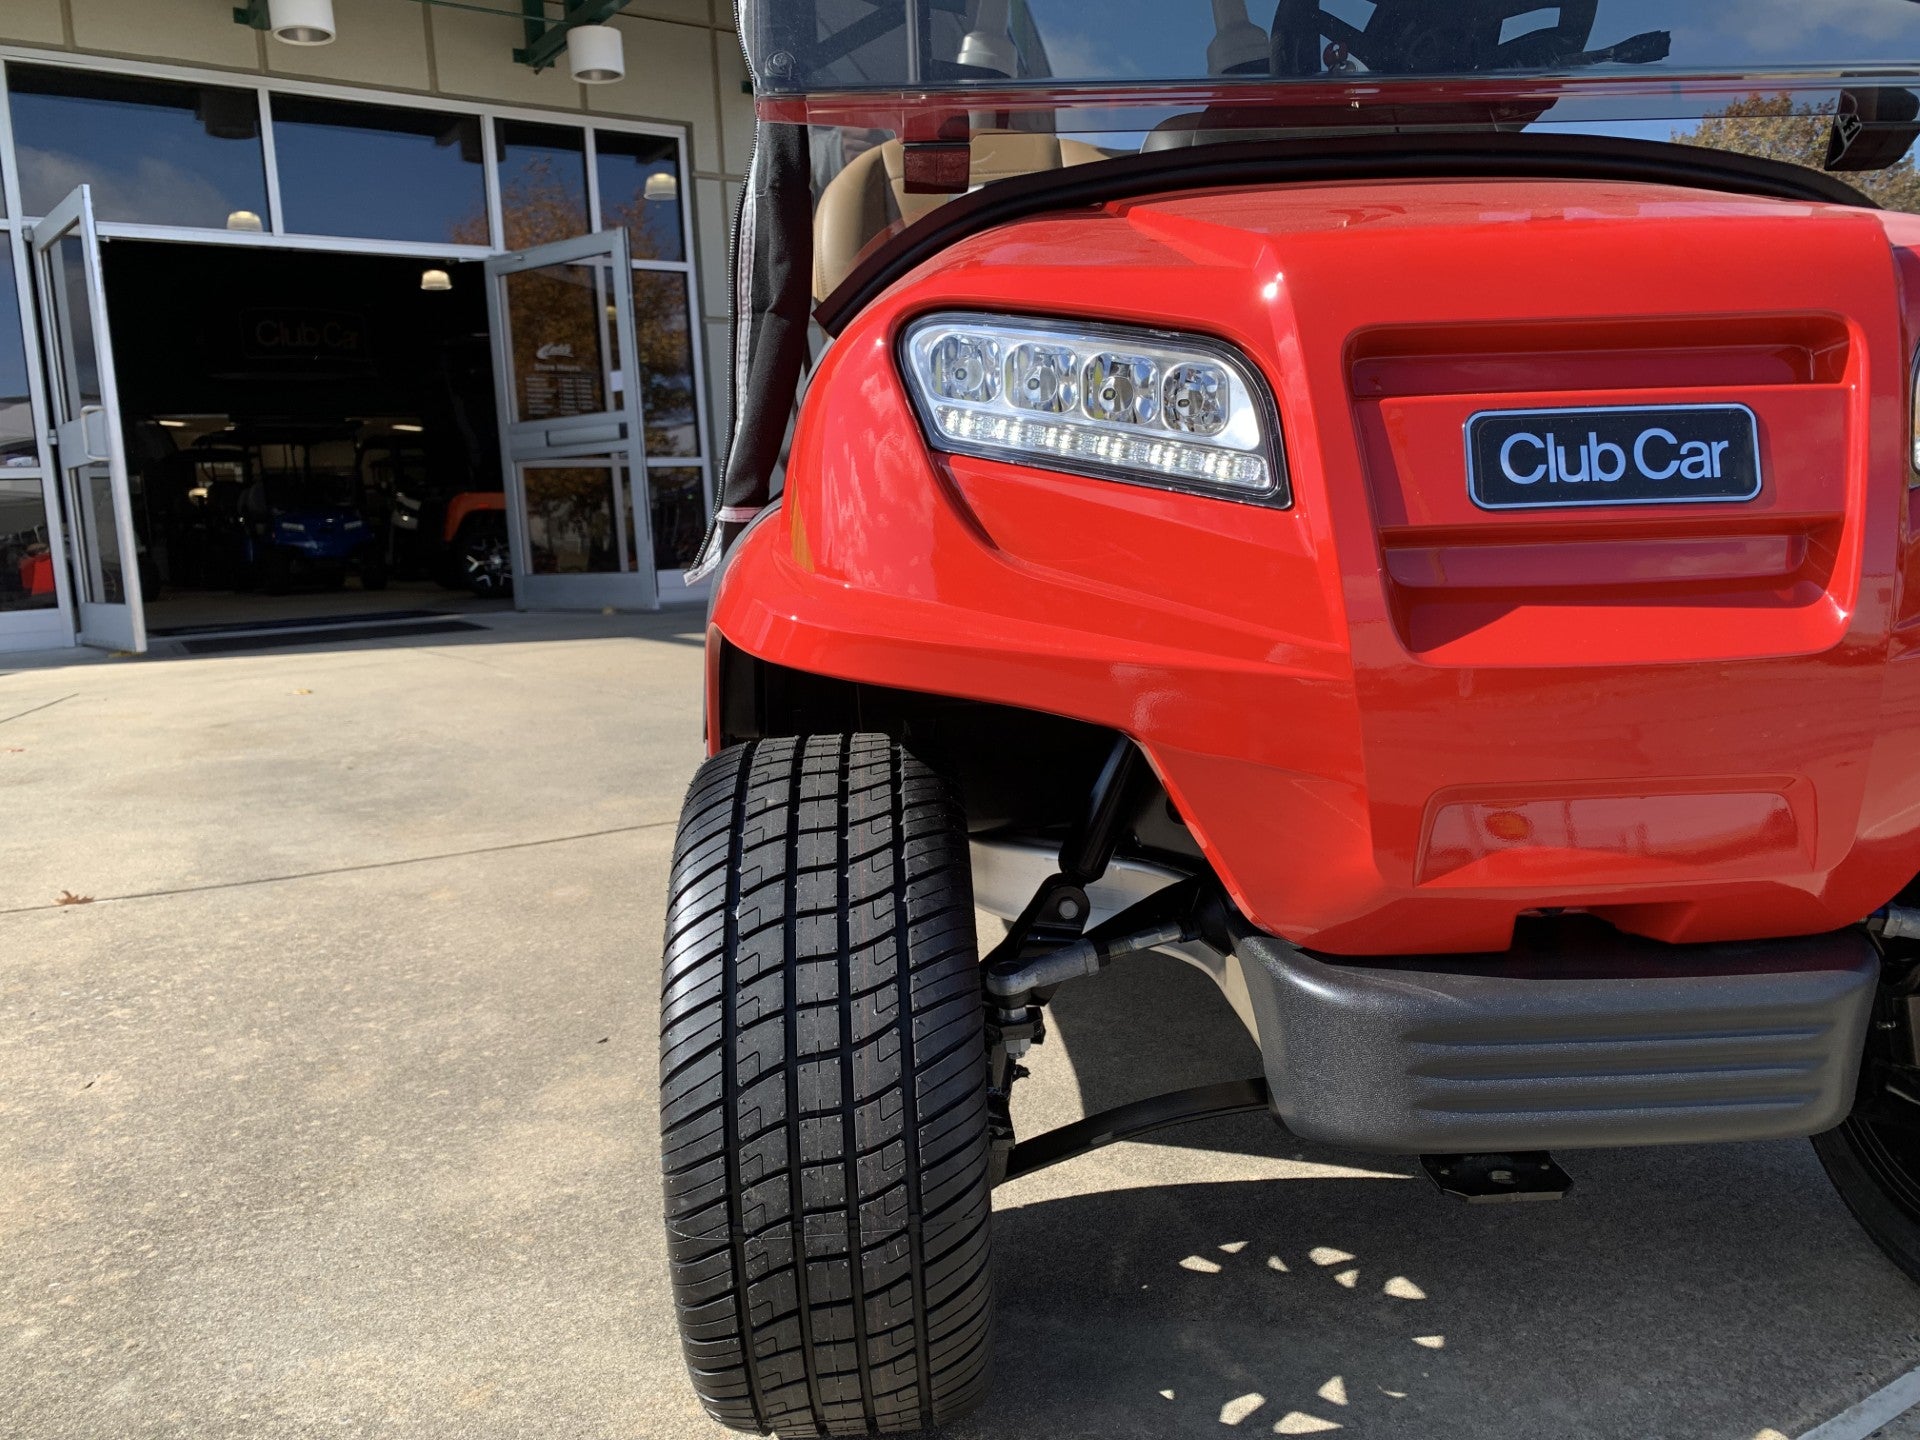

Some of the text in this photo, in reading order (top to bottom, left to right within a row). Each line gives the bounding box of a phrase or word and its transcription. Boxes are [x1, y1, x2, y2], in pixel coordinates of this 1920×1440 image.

[256, 320, 320, 347] Club
[1500, 428, 1729, 484] Club Car
